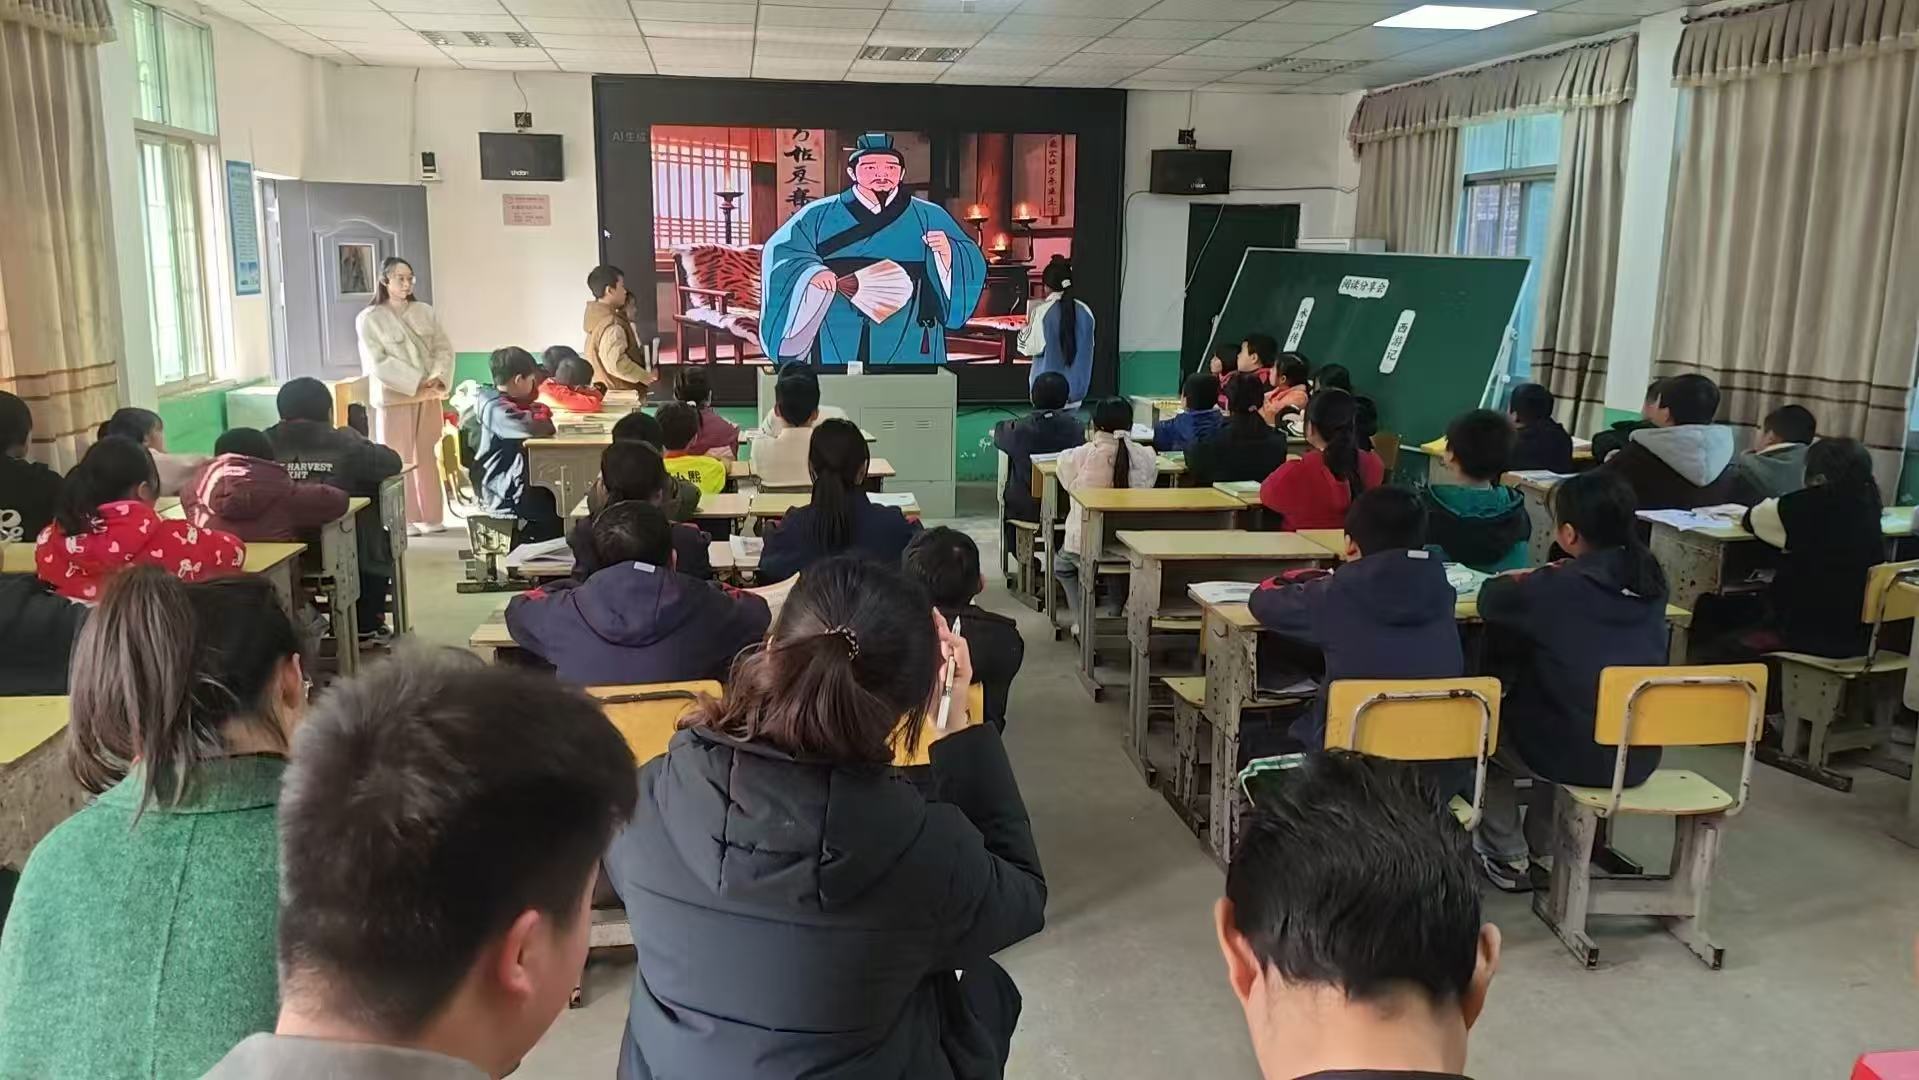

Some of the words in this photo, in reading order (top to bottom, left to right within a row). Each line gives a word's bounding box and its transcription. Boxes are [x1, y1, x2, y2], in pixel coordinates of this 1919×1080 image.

[1341, 279, 1386, 293] 阅读分享会
[1289, 307, 1309, 344] 水浒传
[1386, 322, 1409, 361] 西游记
[287, 462, 333, 471] HARVEST
